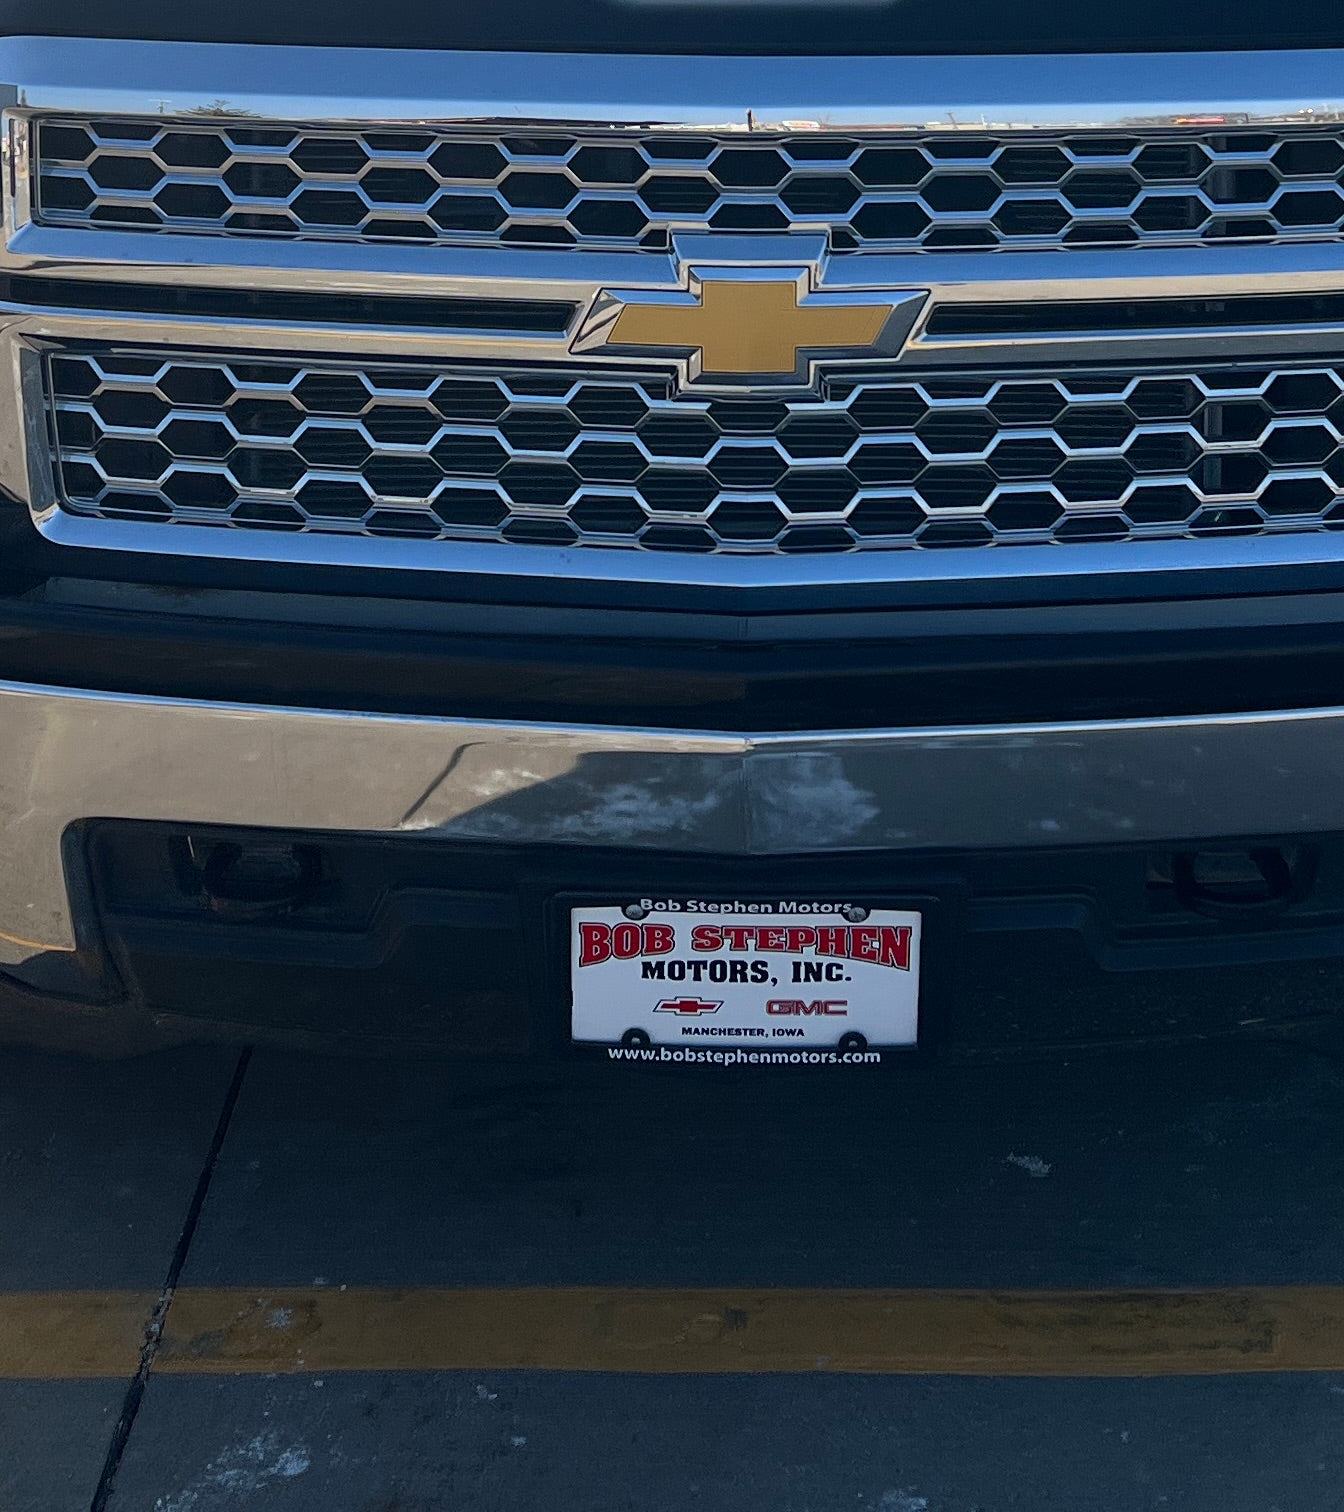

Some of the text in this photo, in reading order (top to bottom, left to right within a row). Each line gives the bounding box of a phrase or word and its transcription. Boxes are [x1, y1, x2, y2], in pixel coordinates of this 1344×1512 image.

[640, 898, 852, 915] Bob Stephen Motors
[578, 922, 913, 972] BOB STEPHEN
[641, 960, 852, 987] MOTORS, INC.
[765, 999, 848, 1016] GMC
[681, 1026, 805, 1038] MANCHESTER, IOWA
[607, 1047, 881, 1066] www.bobstephenmotors.com
